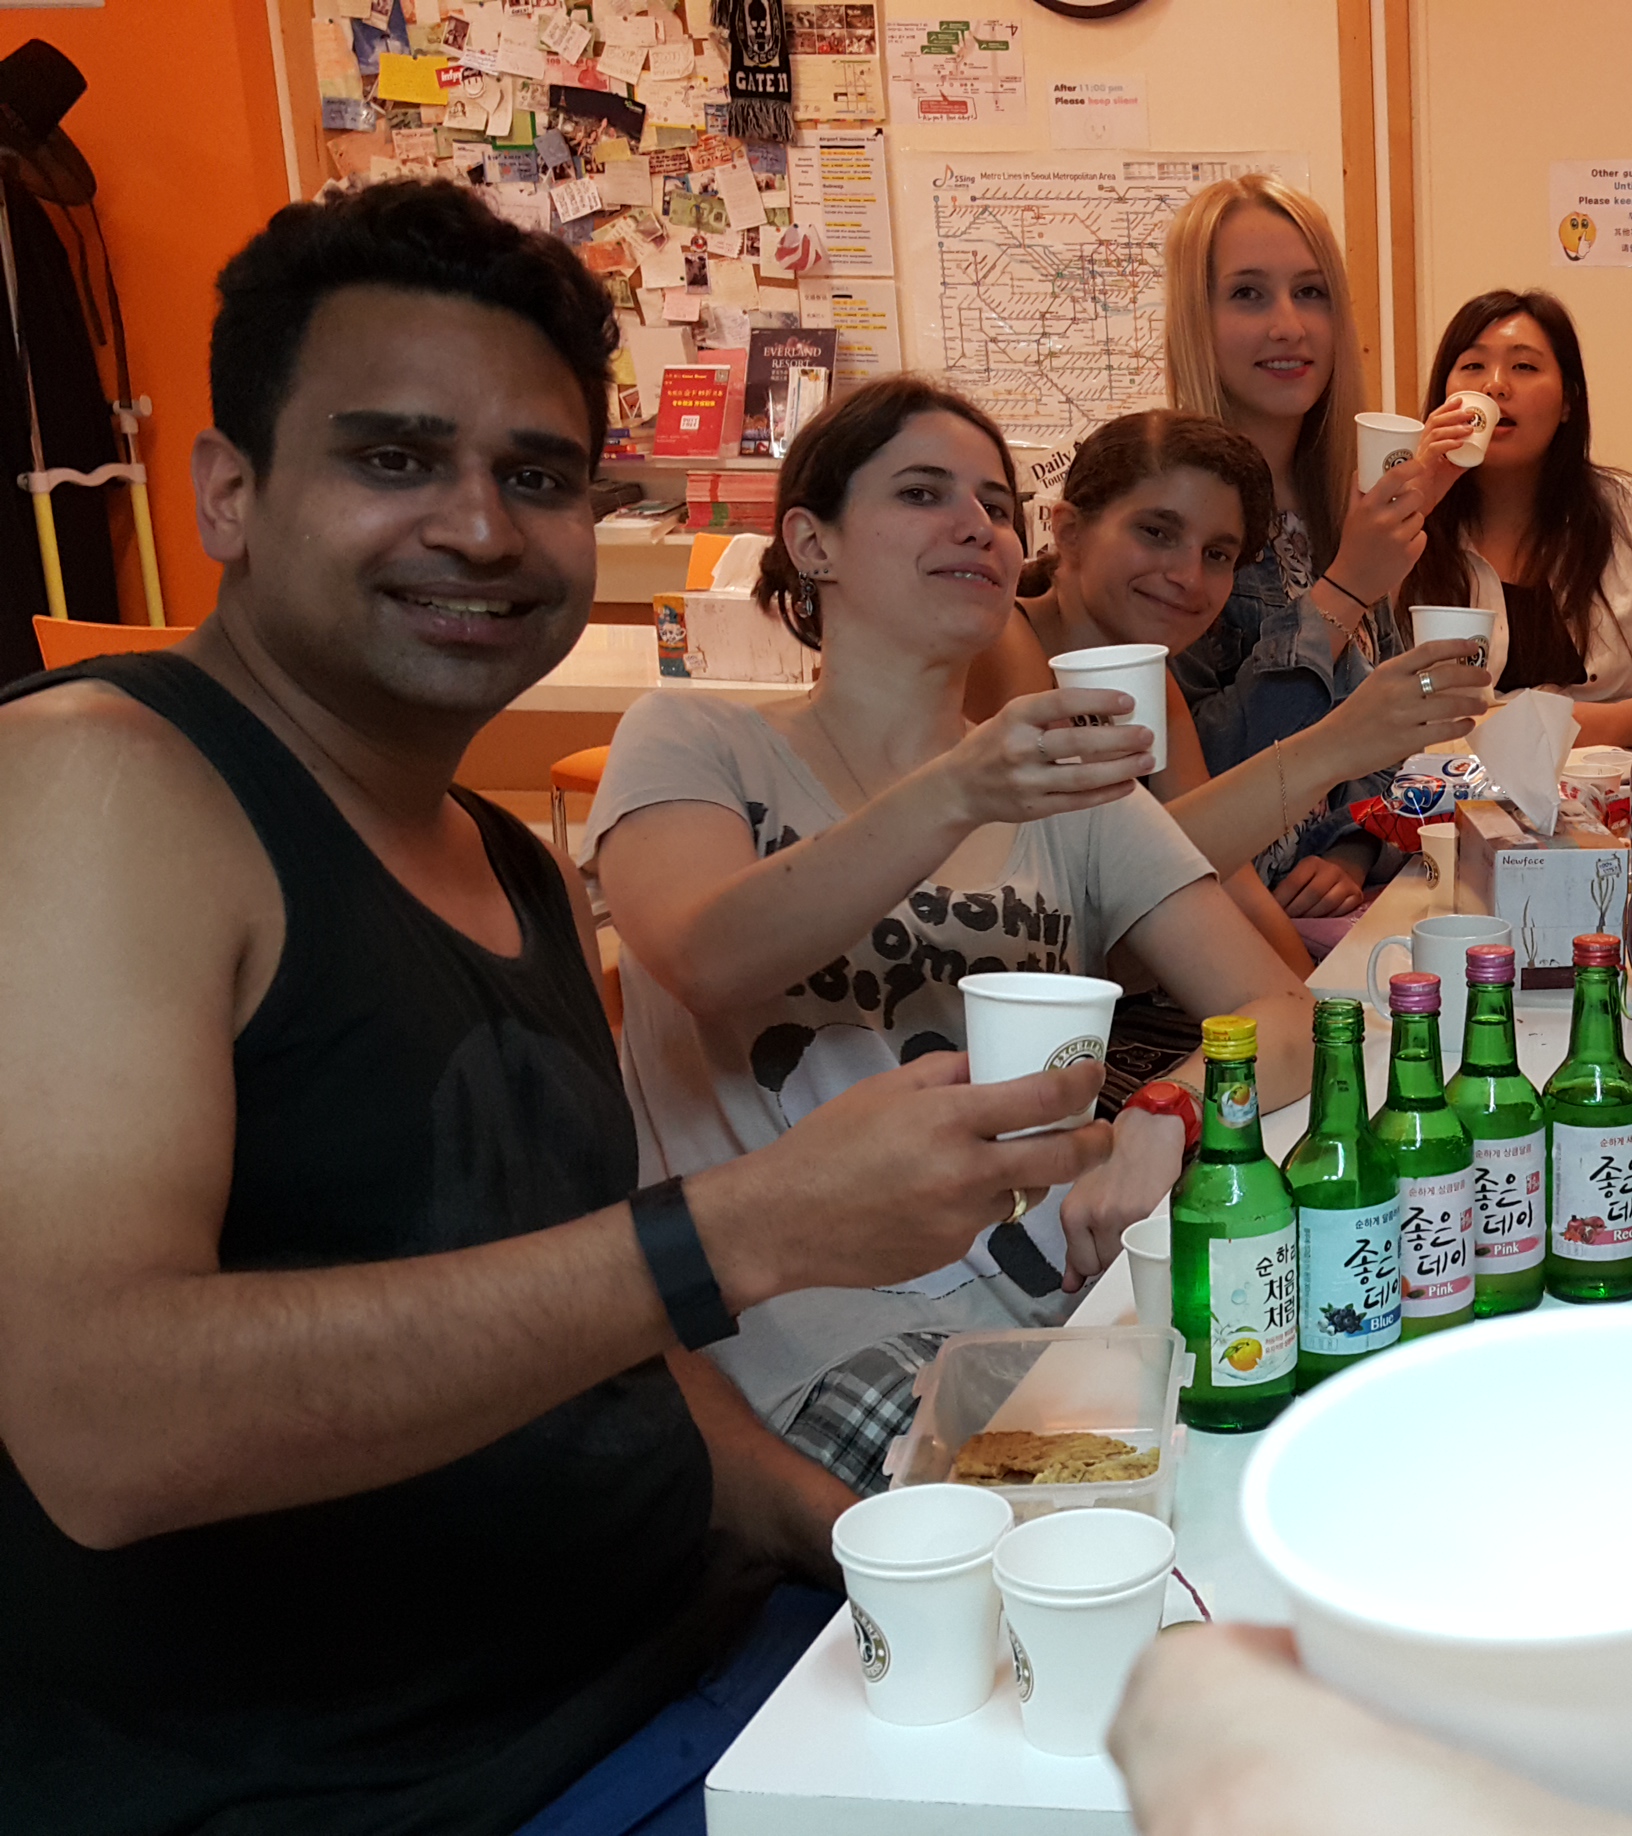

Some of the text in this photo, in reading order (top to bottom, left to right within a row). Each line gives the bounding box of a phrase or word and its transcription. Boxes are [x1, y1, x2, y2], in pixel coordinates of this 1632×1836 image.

[735, 70, 789, 93] GATE 11
[1053, 83, 1123, 93] After 11:00 pm
[1054, 96, 1138, 106] Please keep silent
[980, 172, 1117, 183] Metro Lines in Seoul Metropolitan Area
[1591, 168, 1619, 178] Other
[1578, 196, 1610, 205] Please
[763, 346, 822, 358] EVERLAND
[771, 358, 811, 368] RESORT
[1031, 450, 1072, 481] Daily
[1502, 855, 1545, 866] Newface
[1051, 1039, 1103, 1068] EXCELLE
[1475, 1167, 1523, 1211] 좋은
[1483, 1200, 1533, 1236] 데이
[1400, 1206, 1457, 1252] 좋은
[1417, 1238, 1467, 1277] 데이
[1494, 1242, 1520, 1256] Pink
[1343, 1238, 1396, 1285] 좋은
[1263, 1268, 1295, 1305] 처음
[1428, 1282, 1454, 1297] Pink
[1263, 1295, 1295, 1332] 처럼
[1370, 1313, 1395, 1331] Blue
